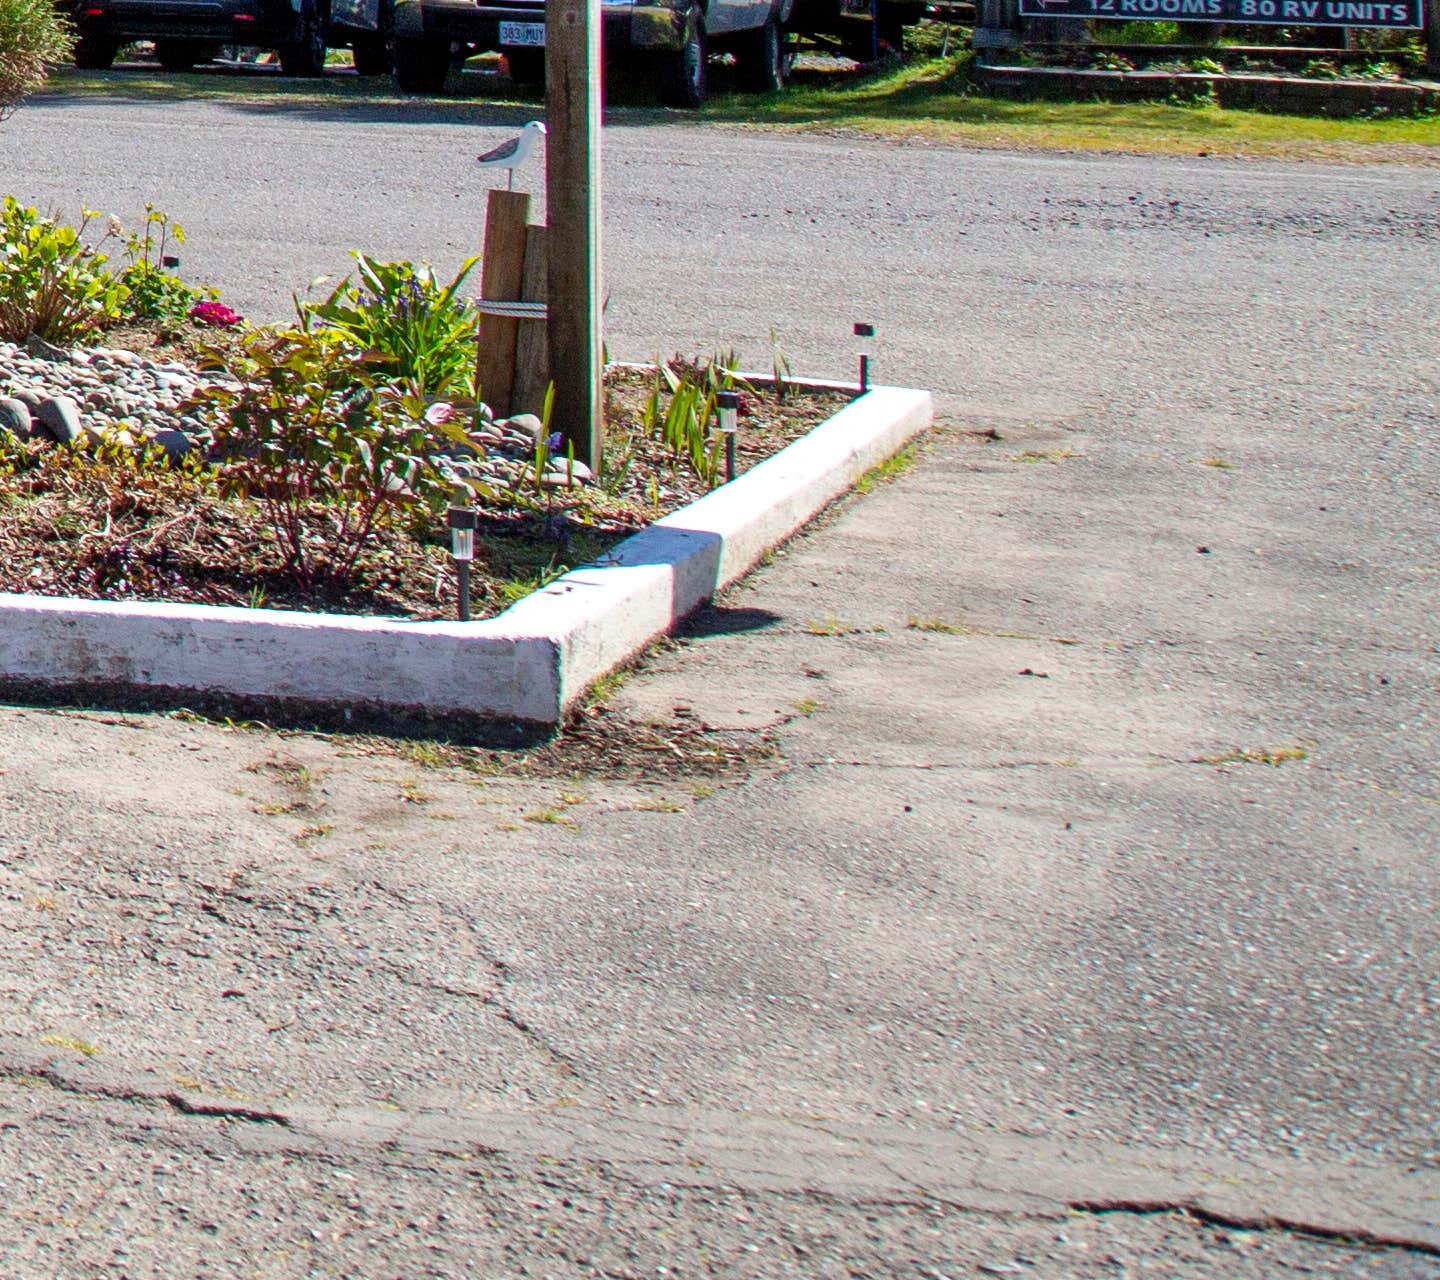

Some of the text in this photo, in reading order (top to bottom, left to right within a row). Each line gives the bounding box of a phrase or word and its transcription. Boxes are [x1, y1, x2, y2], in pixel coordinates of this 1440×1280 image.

[1240, 0, 1275, 17] 80
[1283, 1, 1320, 19] RV
[1325, 2, 1409, 23] UNITS
